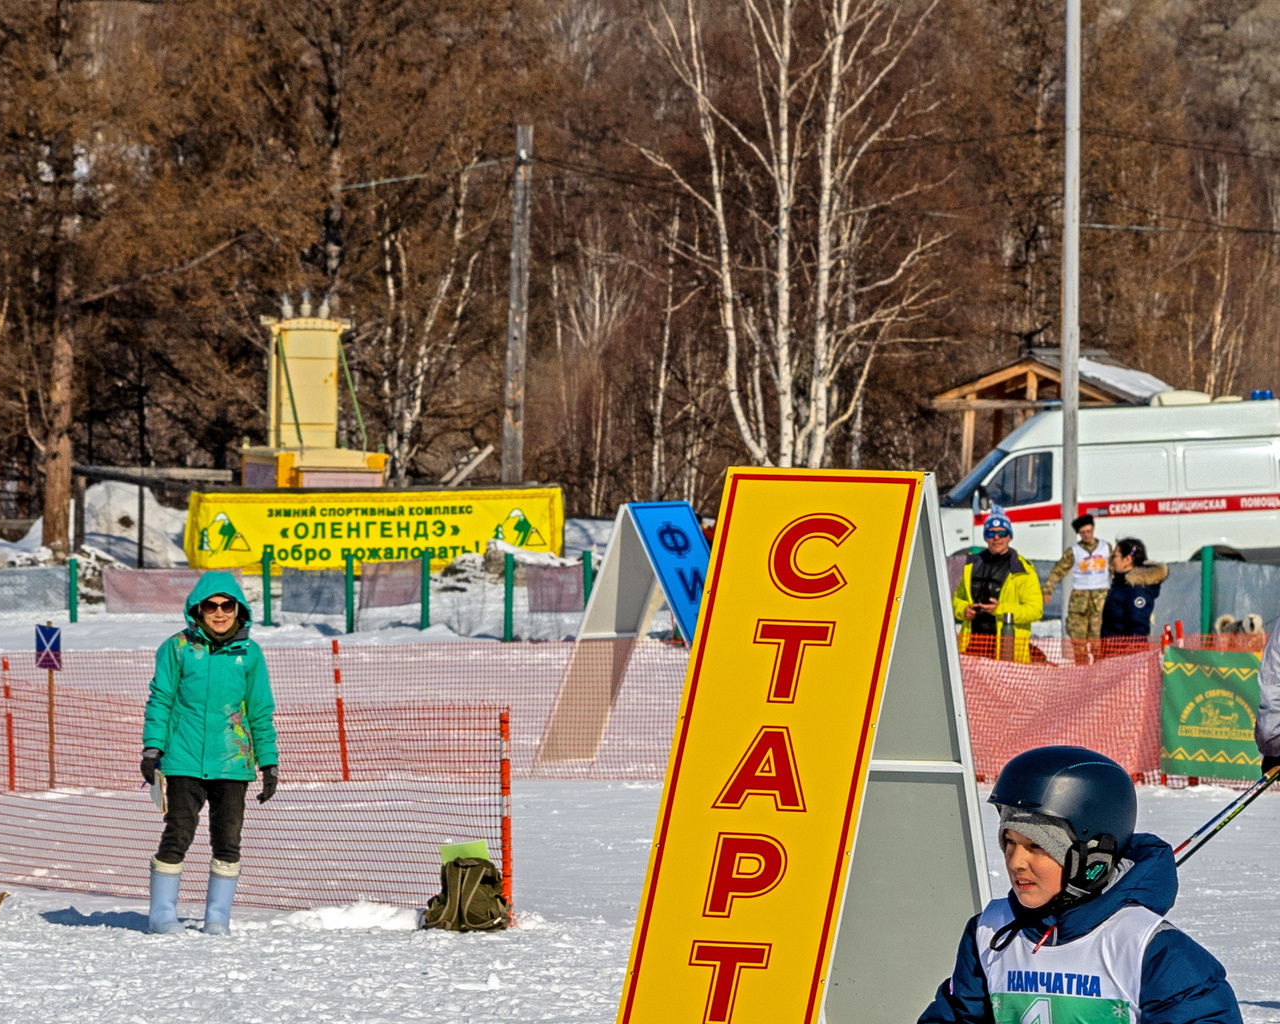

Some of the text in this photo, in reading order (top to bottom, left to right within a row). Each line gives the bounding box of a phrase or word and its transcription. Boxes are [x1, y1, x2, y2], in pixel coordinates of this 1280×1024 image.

[267, 504, 474, 518] ЗИМНИЙ СПОРТИВНЫЙ КОМПЛЕКС
[1109, 502, 1146, 515] СКОРАЯ
[1157, 498, 1227, 513] МЕДИЦИНСКАЯ
[279, 520, 461, 541] «ОЛЕНГЕНДЭ»
[656, 521, 706, 618] ФИ
[1007, 970, 1101, 997] КАМЧАТКА
